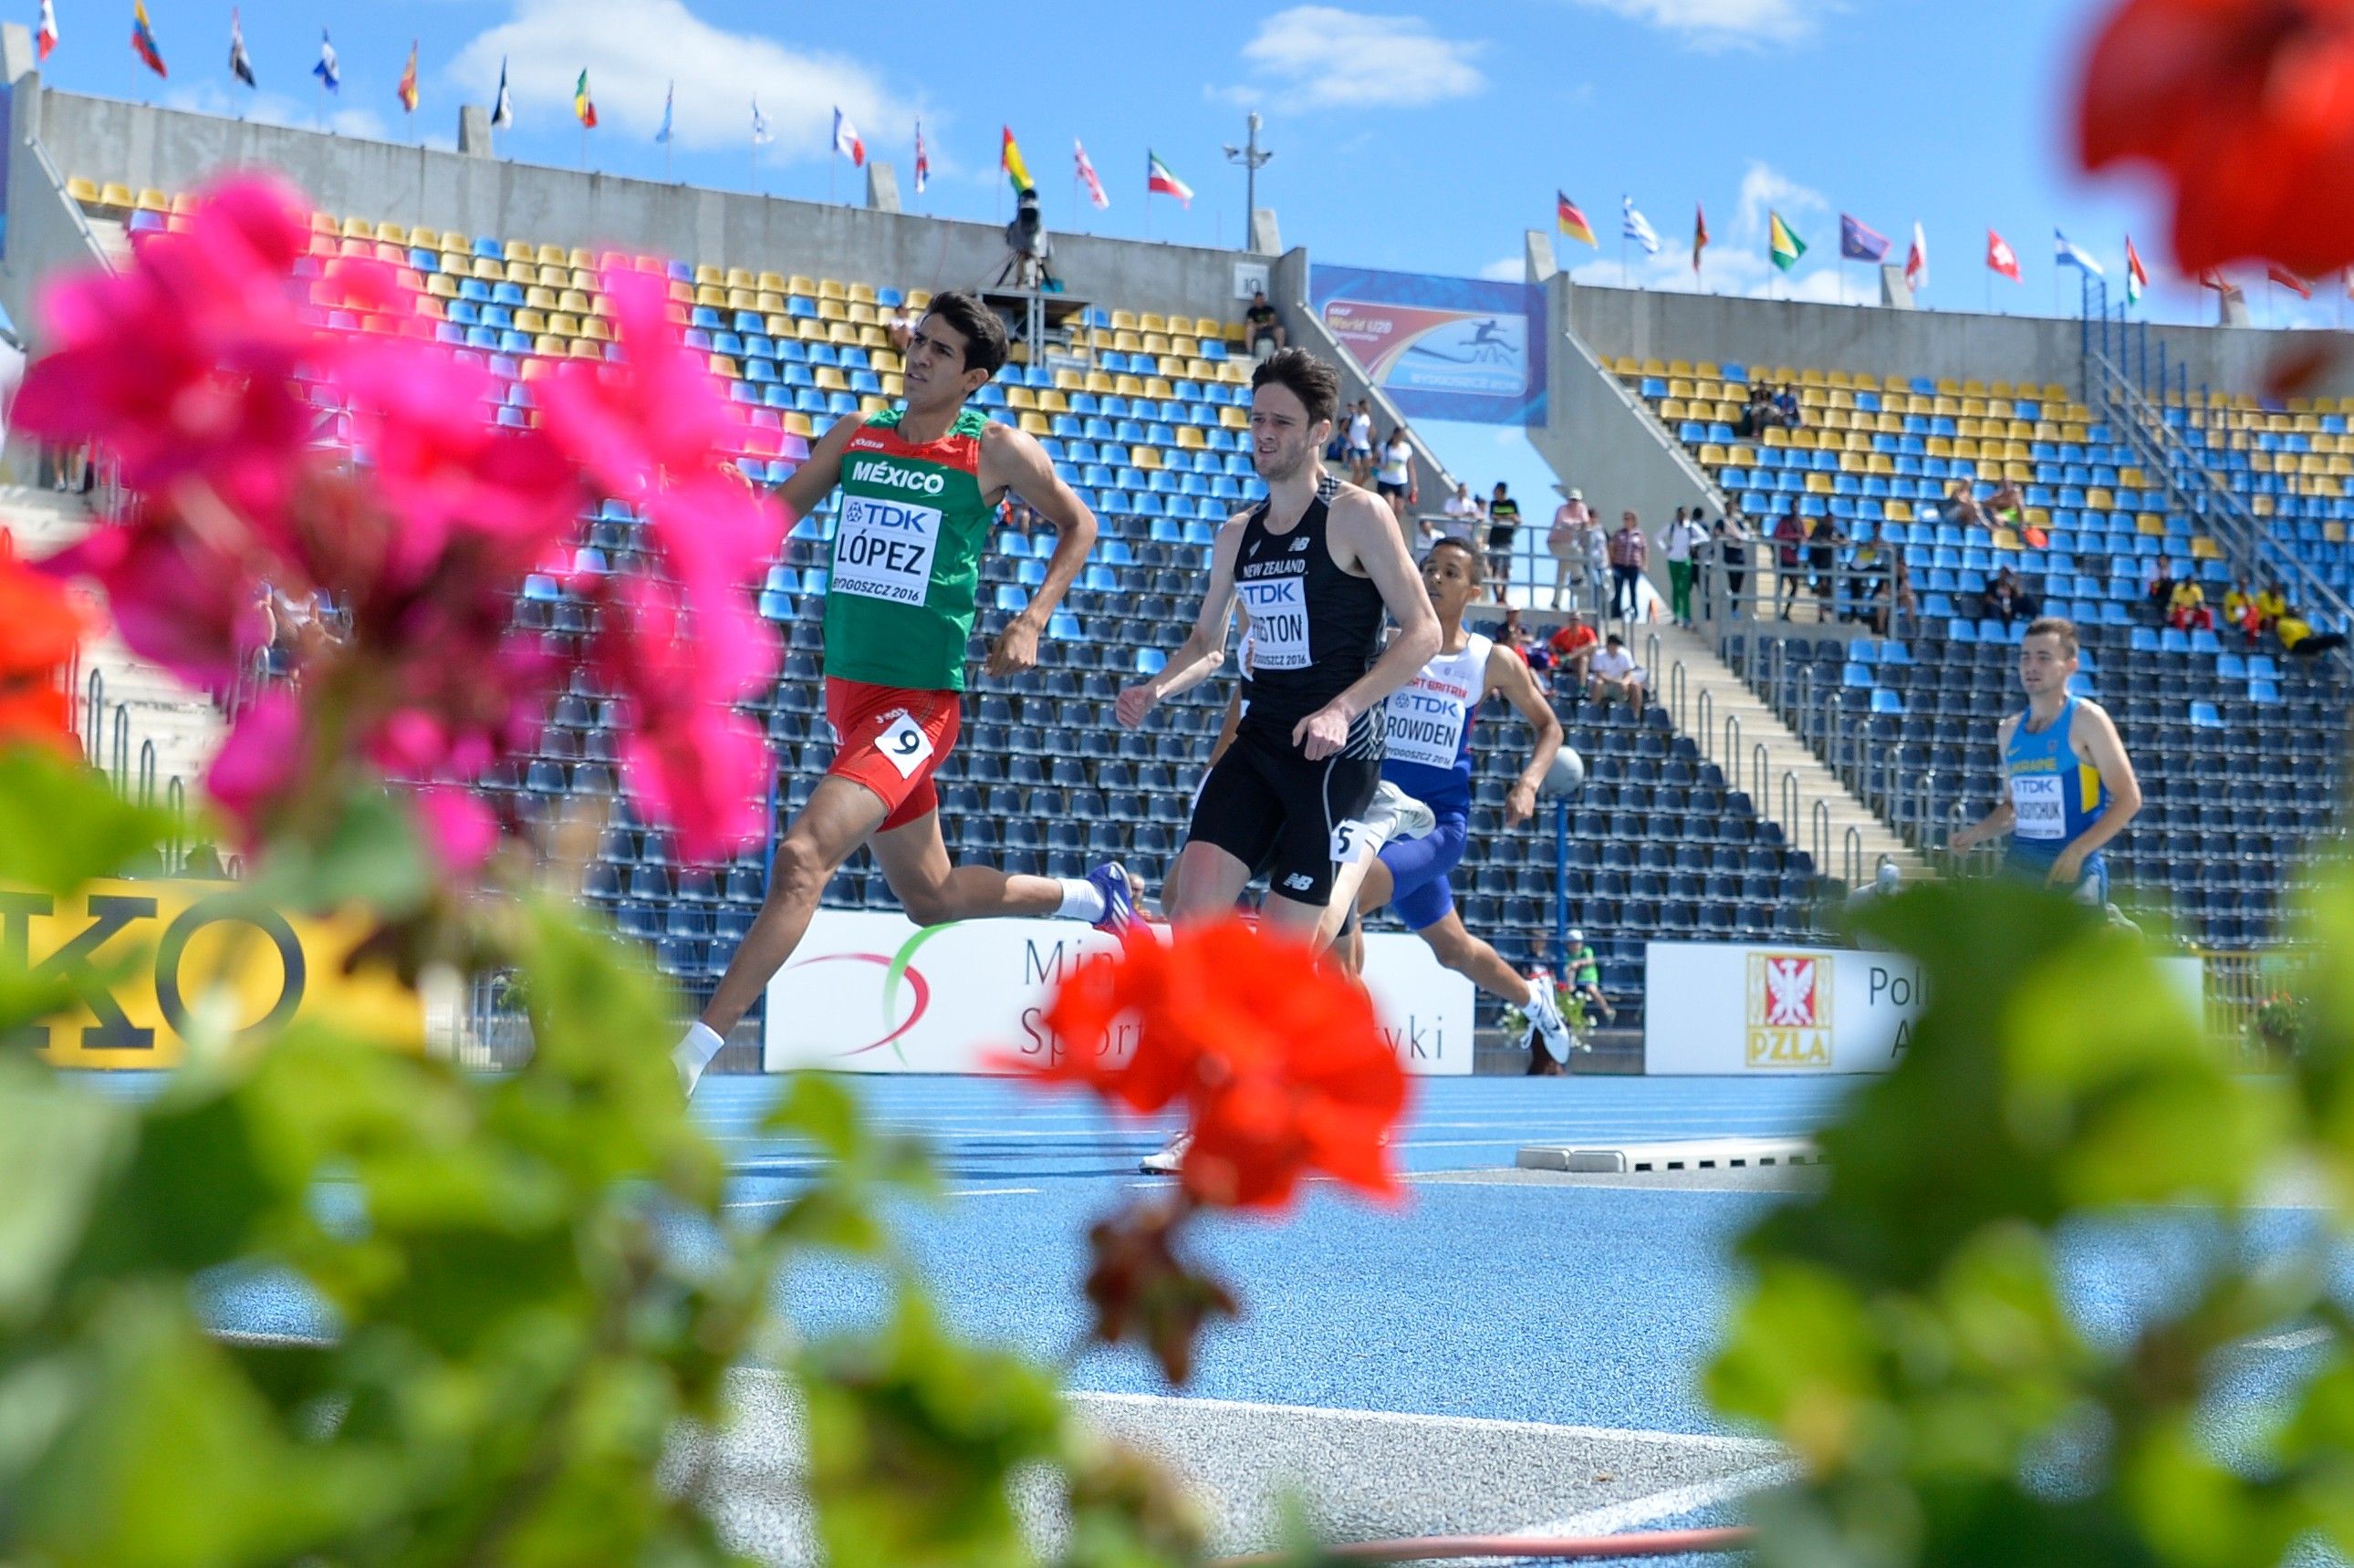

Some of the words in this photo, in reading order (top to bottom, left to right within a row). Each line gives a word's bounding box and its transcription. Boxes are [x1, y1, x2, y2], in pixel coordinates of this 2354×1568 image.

[1367, 319, 1392, 334] U20
[852, 460, 944, 494] MÉXICO
[864, 503, 928, 534] TDK
[838, 528, 926, 576] LÓPEZ
[1243, 562, 1263, 578] NEW
[1263, 558, 1307, 576] ZEALAND
[891, 587, 921, 602] 2016
[1244, 583, 1297, 605] TDK
[1286, 653, 1307, 666] 2016
[1427, 680, 1468, 700] BRITAIN
[1411, 695, 1458, 718] TDK
[892, 730, 920, 754] 9
[1388, 748, 1432, 763] YDGOSZCZ
[1432, 755, 1451, 766] 2016
[2021, 780, 2055, 794] TDK
[1338, 826, 1354, 855] 5
[1870, 967, 1929, 1005] Pol
[1021, 1007, 1146, 1066] Sport
[1751, 1032, 1825, 1061] PZLA
